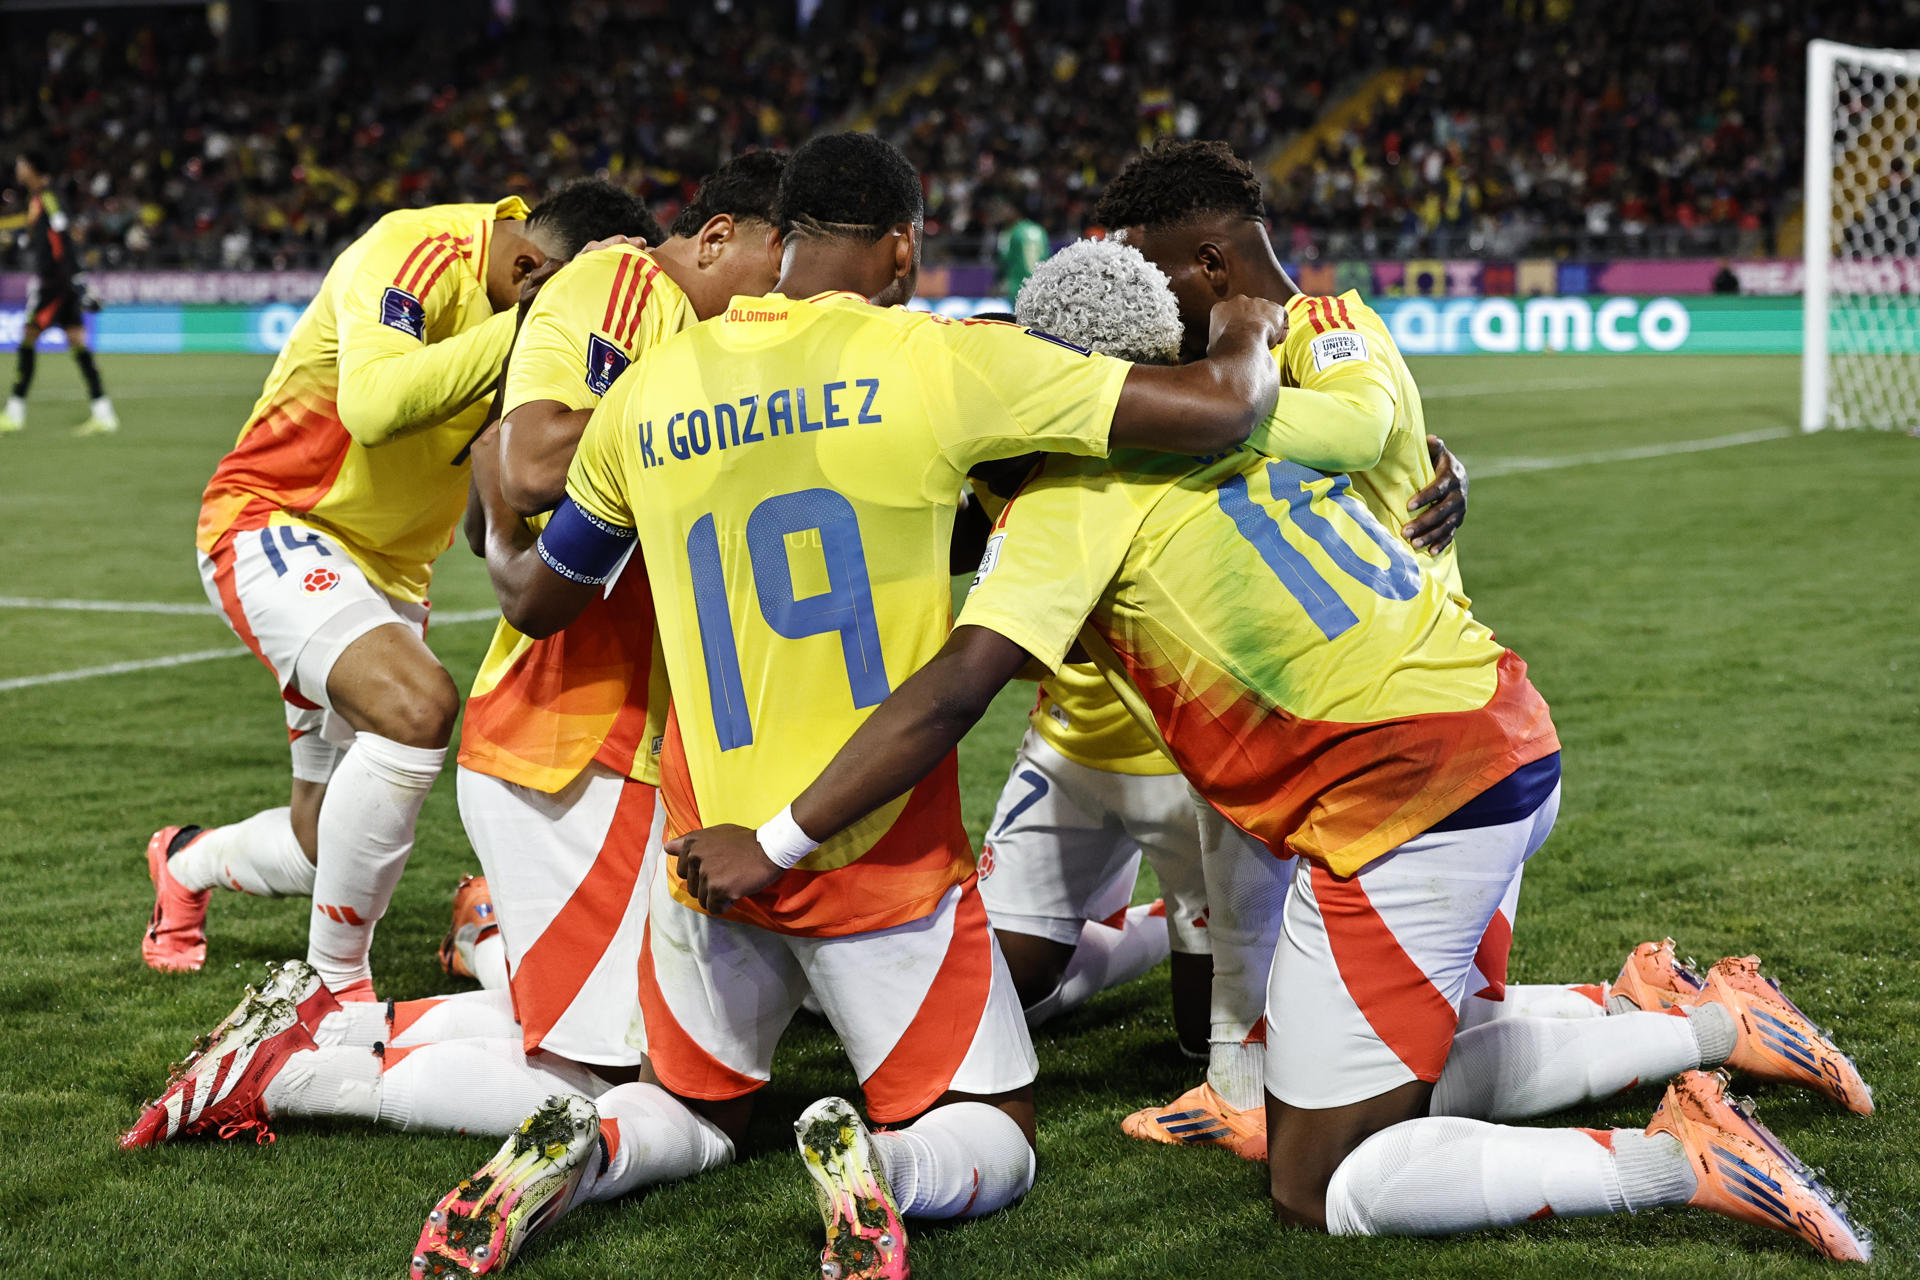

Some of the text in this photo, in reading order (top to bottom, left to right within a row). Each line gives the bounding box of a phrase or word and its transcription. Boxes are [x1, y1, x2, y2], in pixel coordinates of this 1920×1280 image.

[725, 309, 788, 323] COLOMBIA
[1323, 340, 1356, 351] UNITES
[1391, 297, 1691, 352] aramco
[638, 378, 882, 469] K. GONZALEZ
[260, 525, 333, 578] 14
[1217, 460, 1422, 641] 10
[686, 488, 892, 753] 19
[994, 769, 1049, 837] 7
